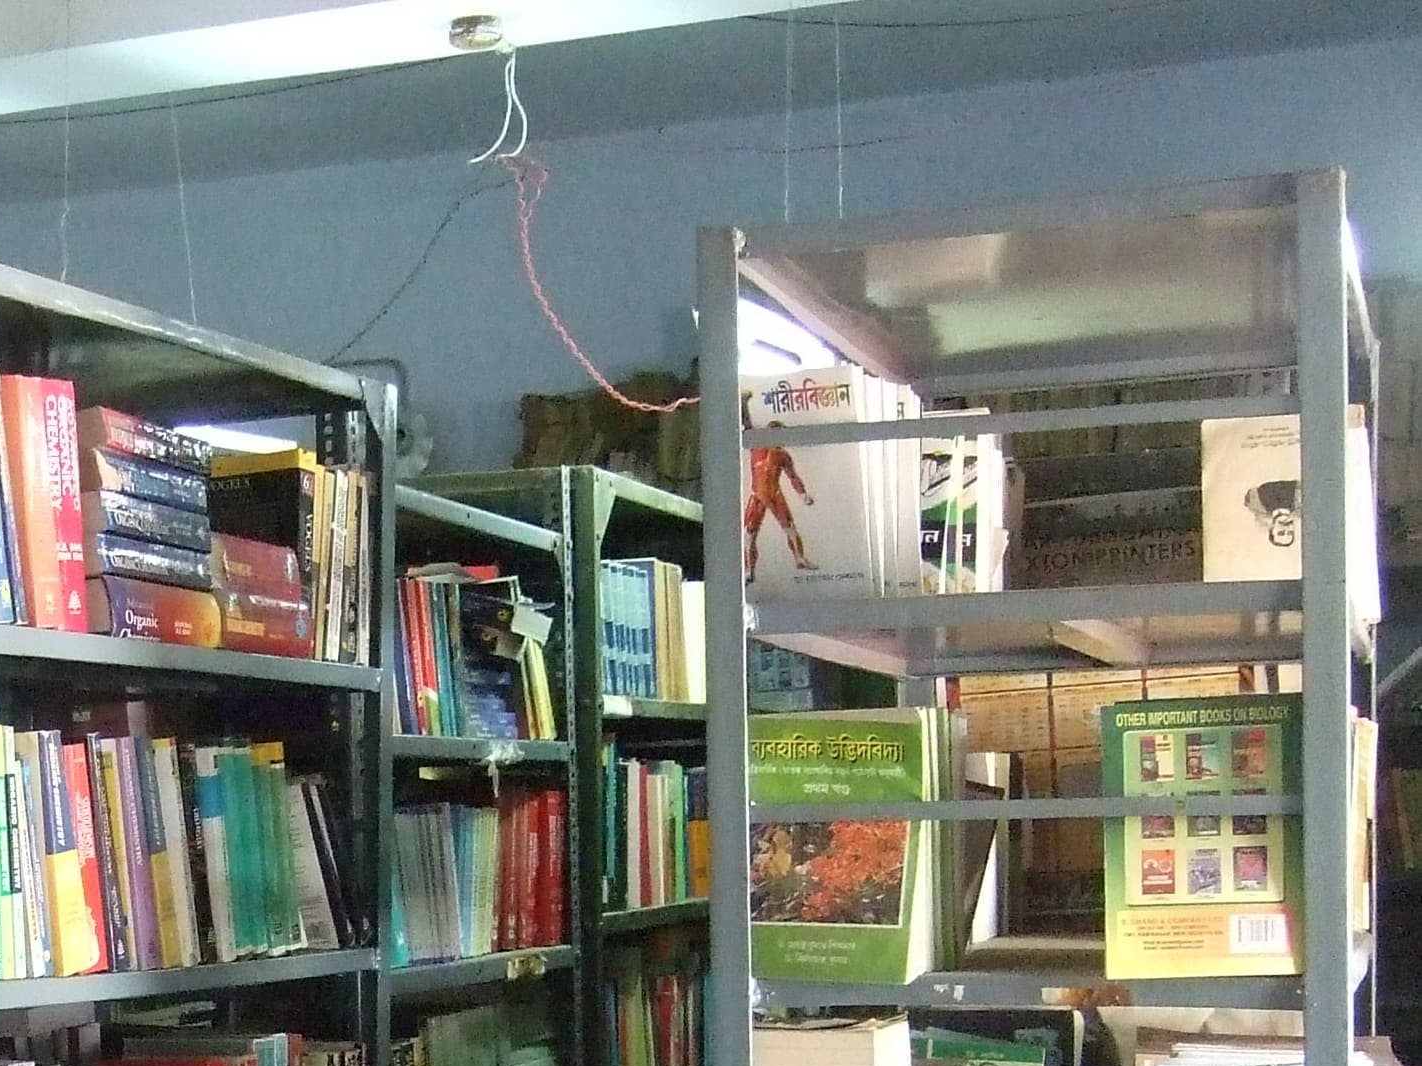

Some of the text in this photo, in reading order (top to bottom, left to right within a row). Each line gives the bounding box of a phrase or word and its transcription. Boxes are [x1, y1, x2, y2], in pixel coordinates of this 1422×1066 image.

[46, 394, 62, 511] CHEMISTRY
[58, 396, 73, 497] ORGANIC
[125, 608, 159, 631] Organic
[1115, 705, 1289, 727] OTHER IMPORTANT BOOKS ON BIOLOGY
[9, 777, 22, 890] ORGANIC CHEMISTRY
[53, 786, 66, 847] CHEMISTRY
